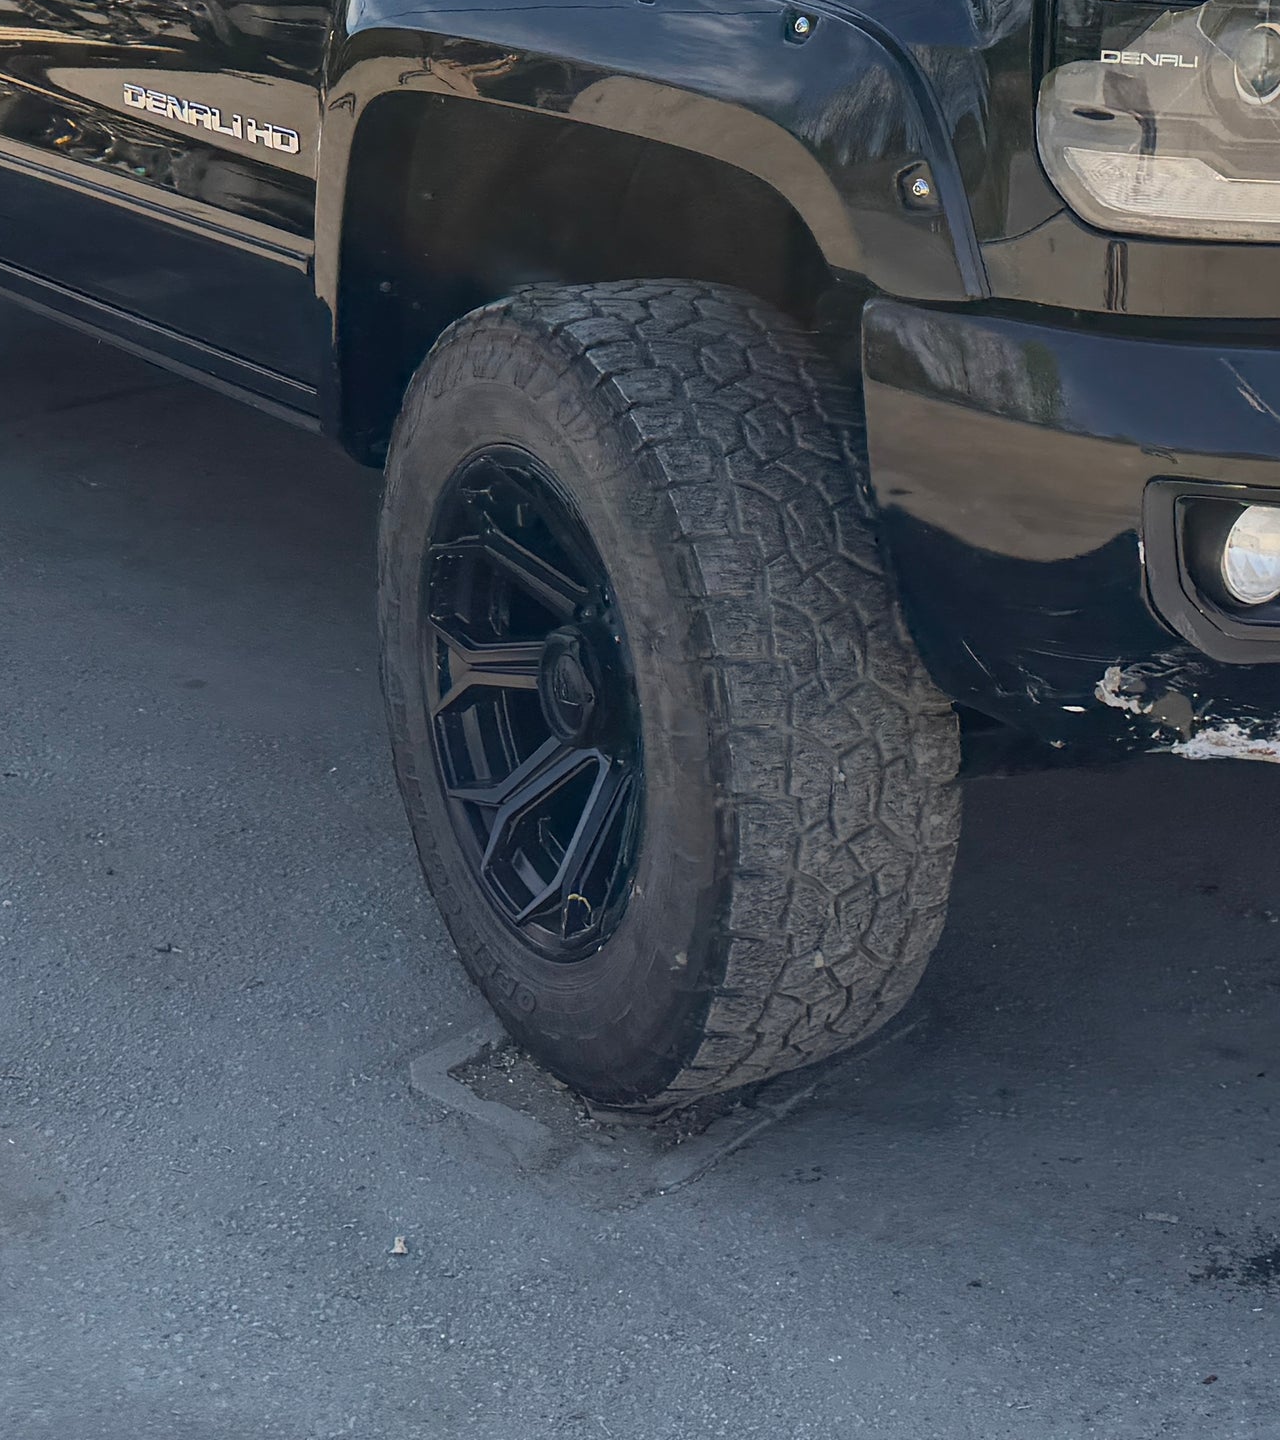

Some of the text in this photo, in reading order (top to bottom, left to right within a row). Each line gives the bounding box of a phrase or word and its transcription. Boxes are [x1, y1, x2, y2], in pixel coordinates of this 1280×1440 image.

[1100, 49, 1199, 69] DENALI
[122, 82, 302, 155] DENALI HD
